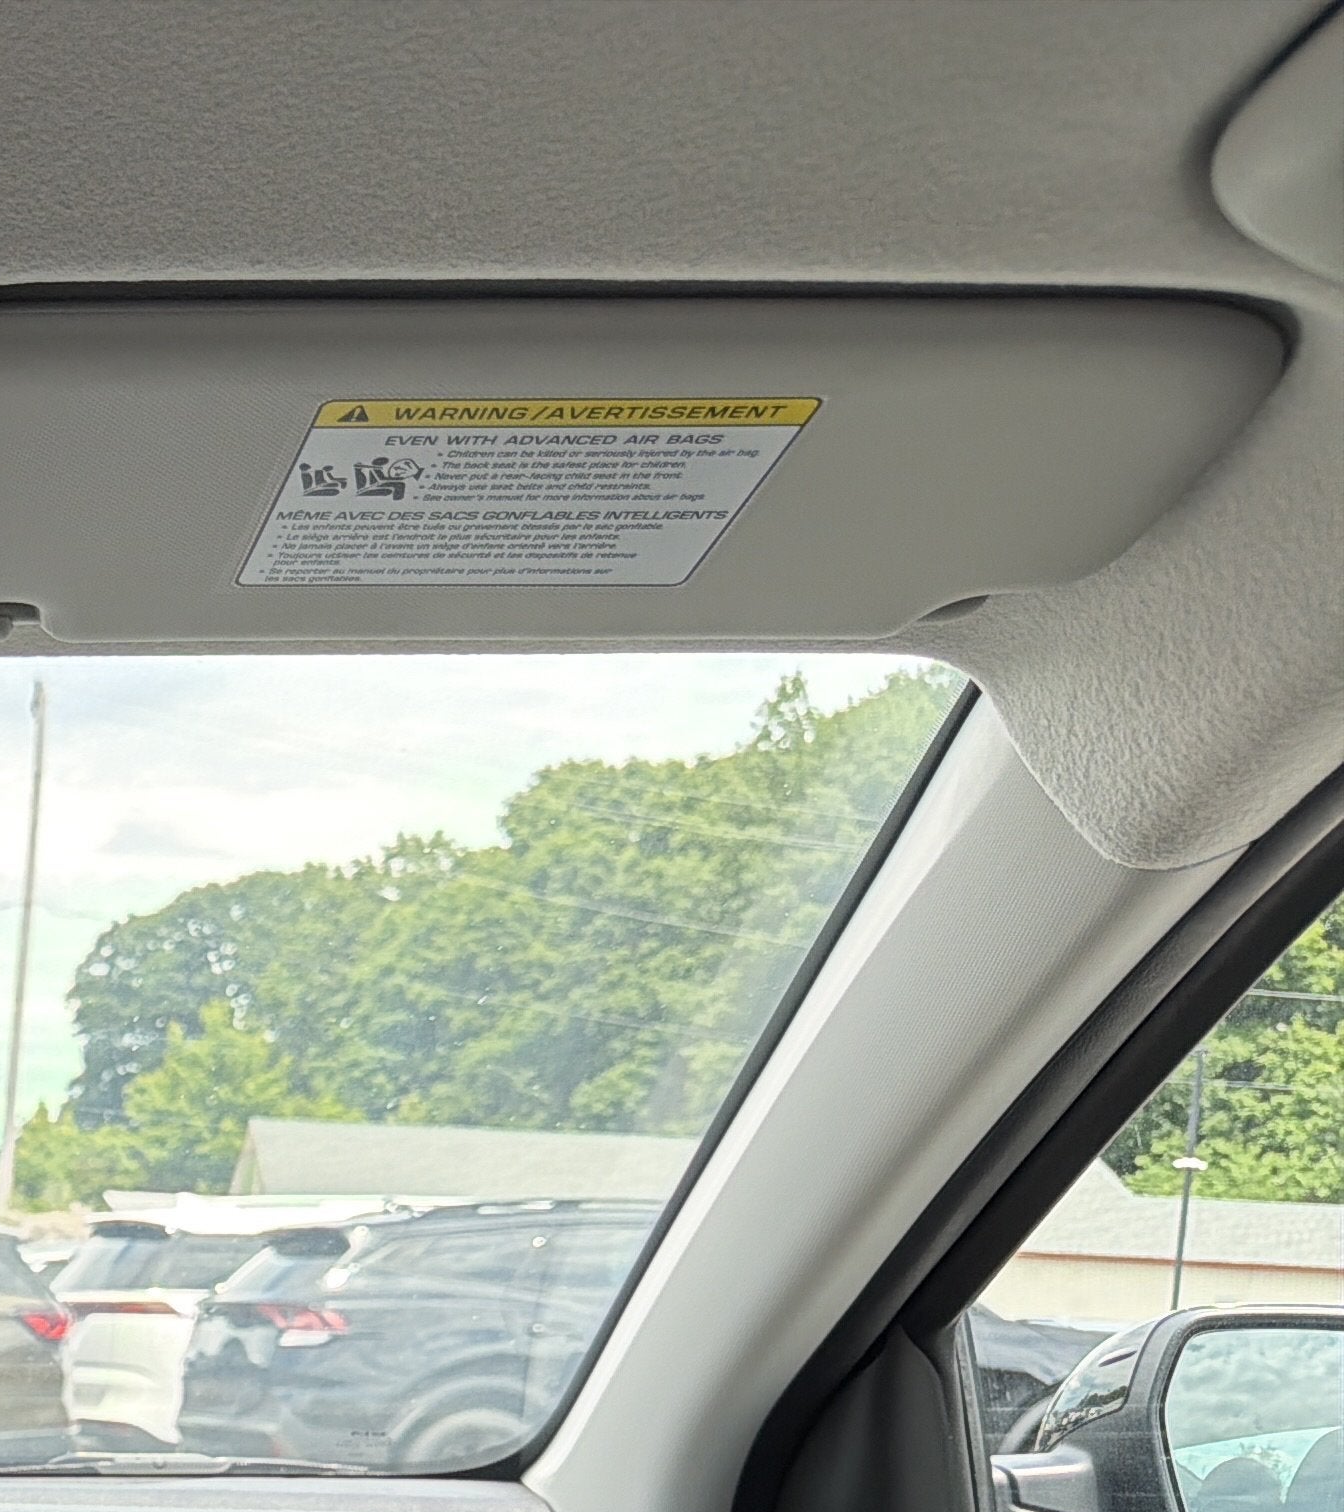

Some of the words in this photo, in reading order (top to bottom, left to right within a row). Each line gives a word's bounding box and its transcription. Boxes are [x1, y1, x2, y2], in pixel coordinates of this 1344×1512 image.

[385, 435, 438, 446] EVEN
[447, 435, 497, 446] WITH
[503, 435, 617, 446] ADVANCED
[624, 434, 659, 445] AIR
[666, 434, 724, 445] BAGS
[275, 509, 332, 521] MÊME
[334, 511, 385, 521] AVEC
[387, 511, 425, 521] DES
[427, 511, 479, 521] SACS
[482, 510, 601, 521] GONFLABLES
[603, 510, 730, 520] INTELLIGENTS
